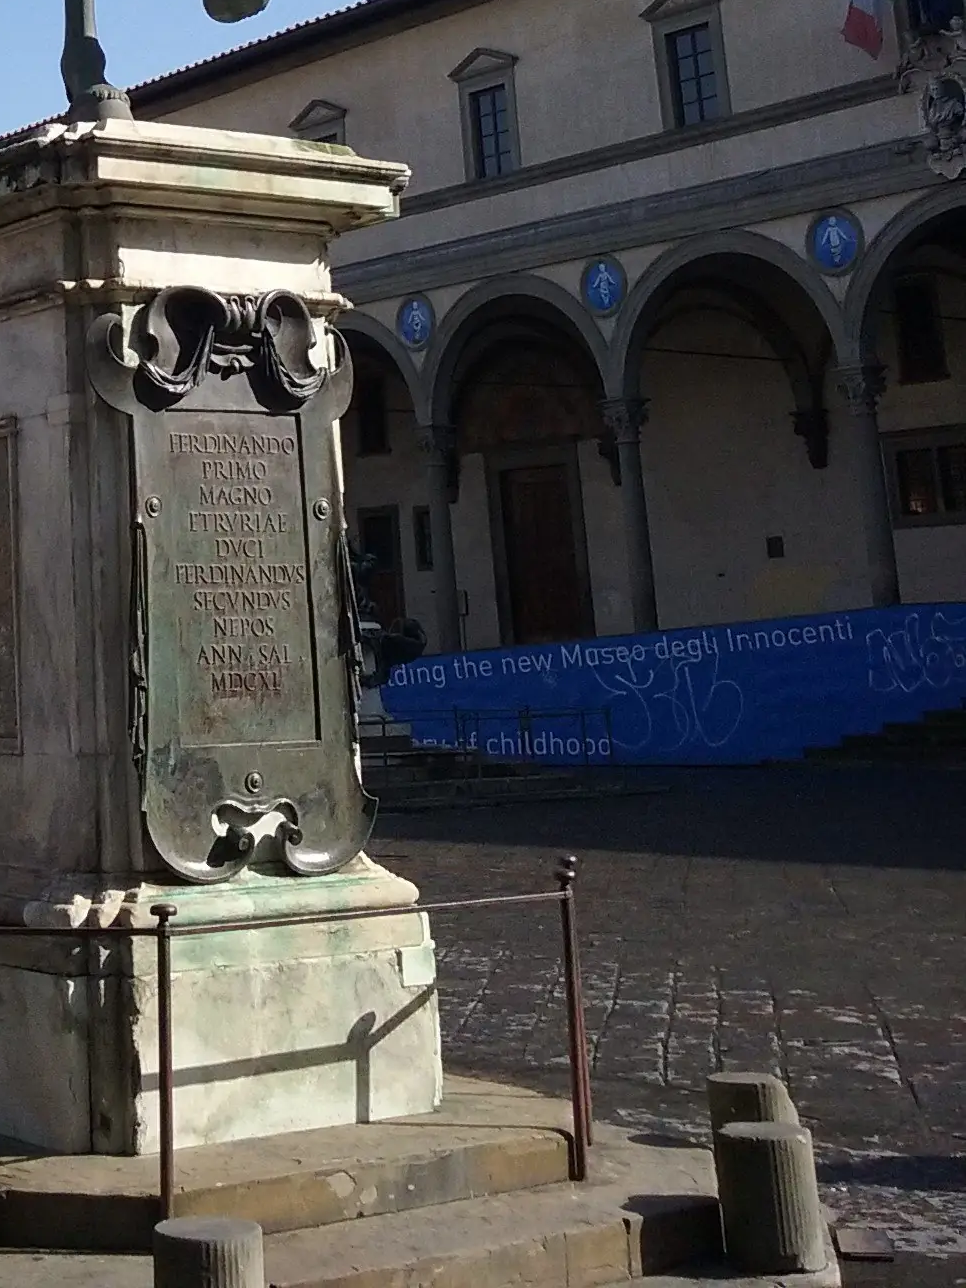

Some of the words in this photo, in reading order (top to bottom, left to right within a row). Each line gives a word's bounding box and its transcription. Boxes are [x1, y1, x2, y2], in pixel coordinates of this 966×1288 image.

[168, 431, 295, 455] FERDINANDO
[201, 459, 267, 481] PRIMO
[198, 485, 272, 506] MAGNO
[188, 512, 288, 533] ETRVRIAE
[214, 538, 265, 559] DVCI
[174, 563, 306, 585] FERDINANDVS
[193, 590, 291, 611] SECVNDVS
[212, 617, 276, 637] NEPOS
[452, 655, 493, 680] the
[501, 650, 554, 675] new
[561, 642, 646, 669] Museo
[654, 629, 718, 662] degli
[726, 615, 855, 653] Innocenti
[210, 671, 282, 692] MDCXL
